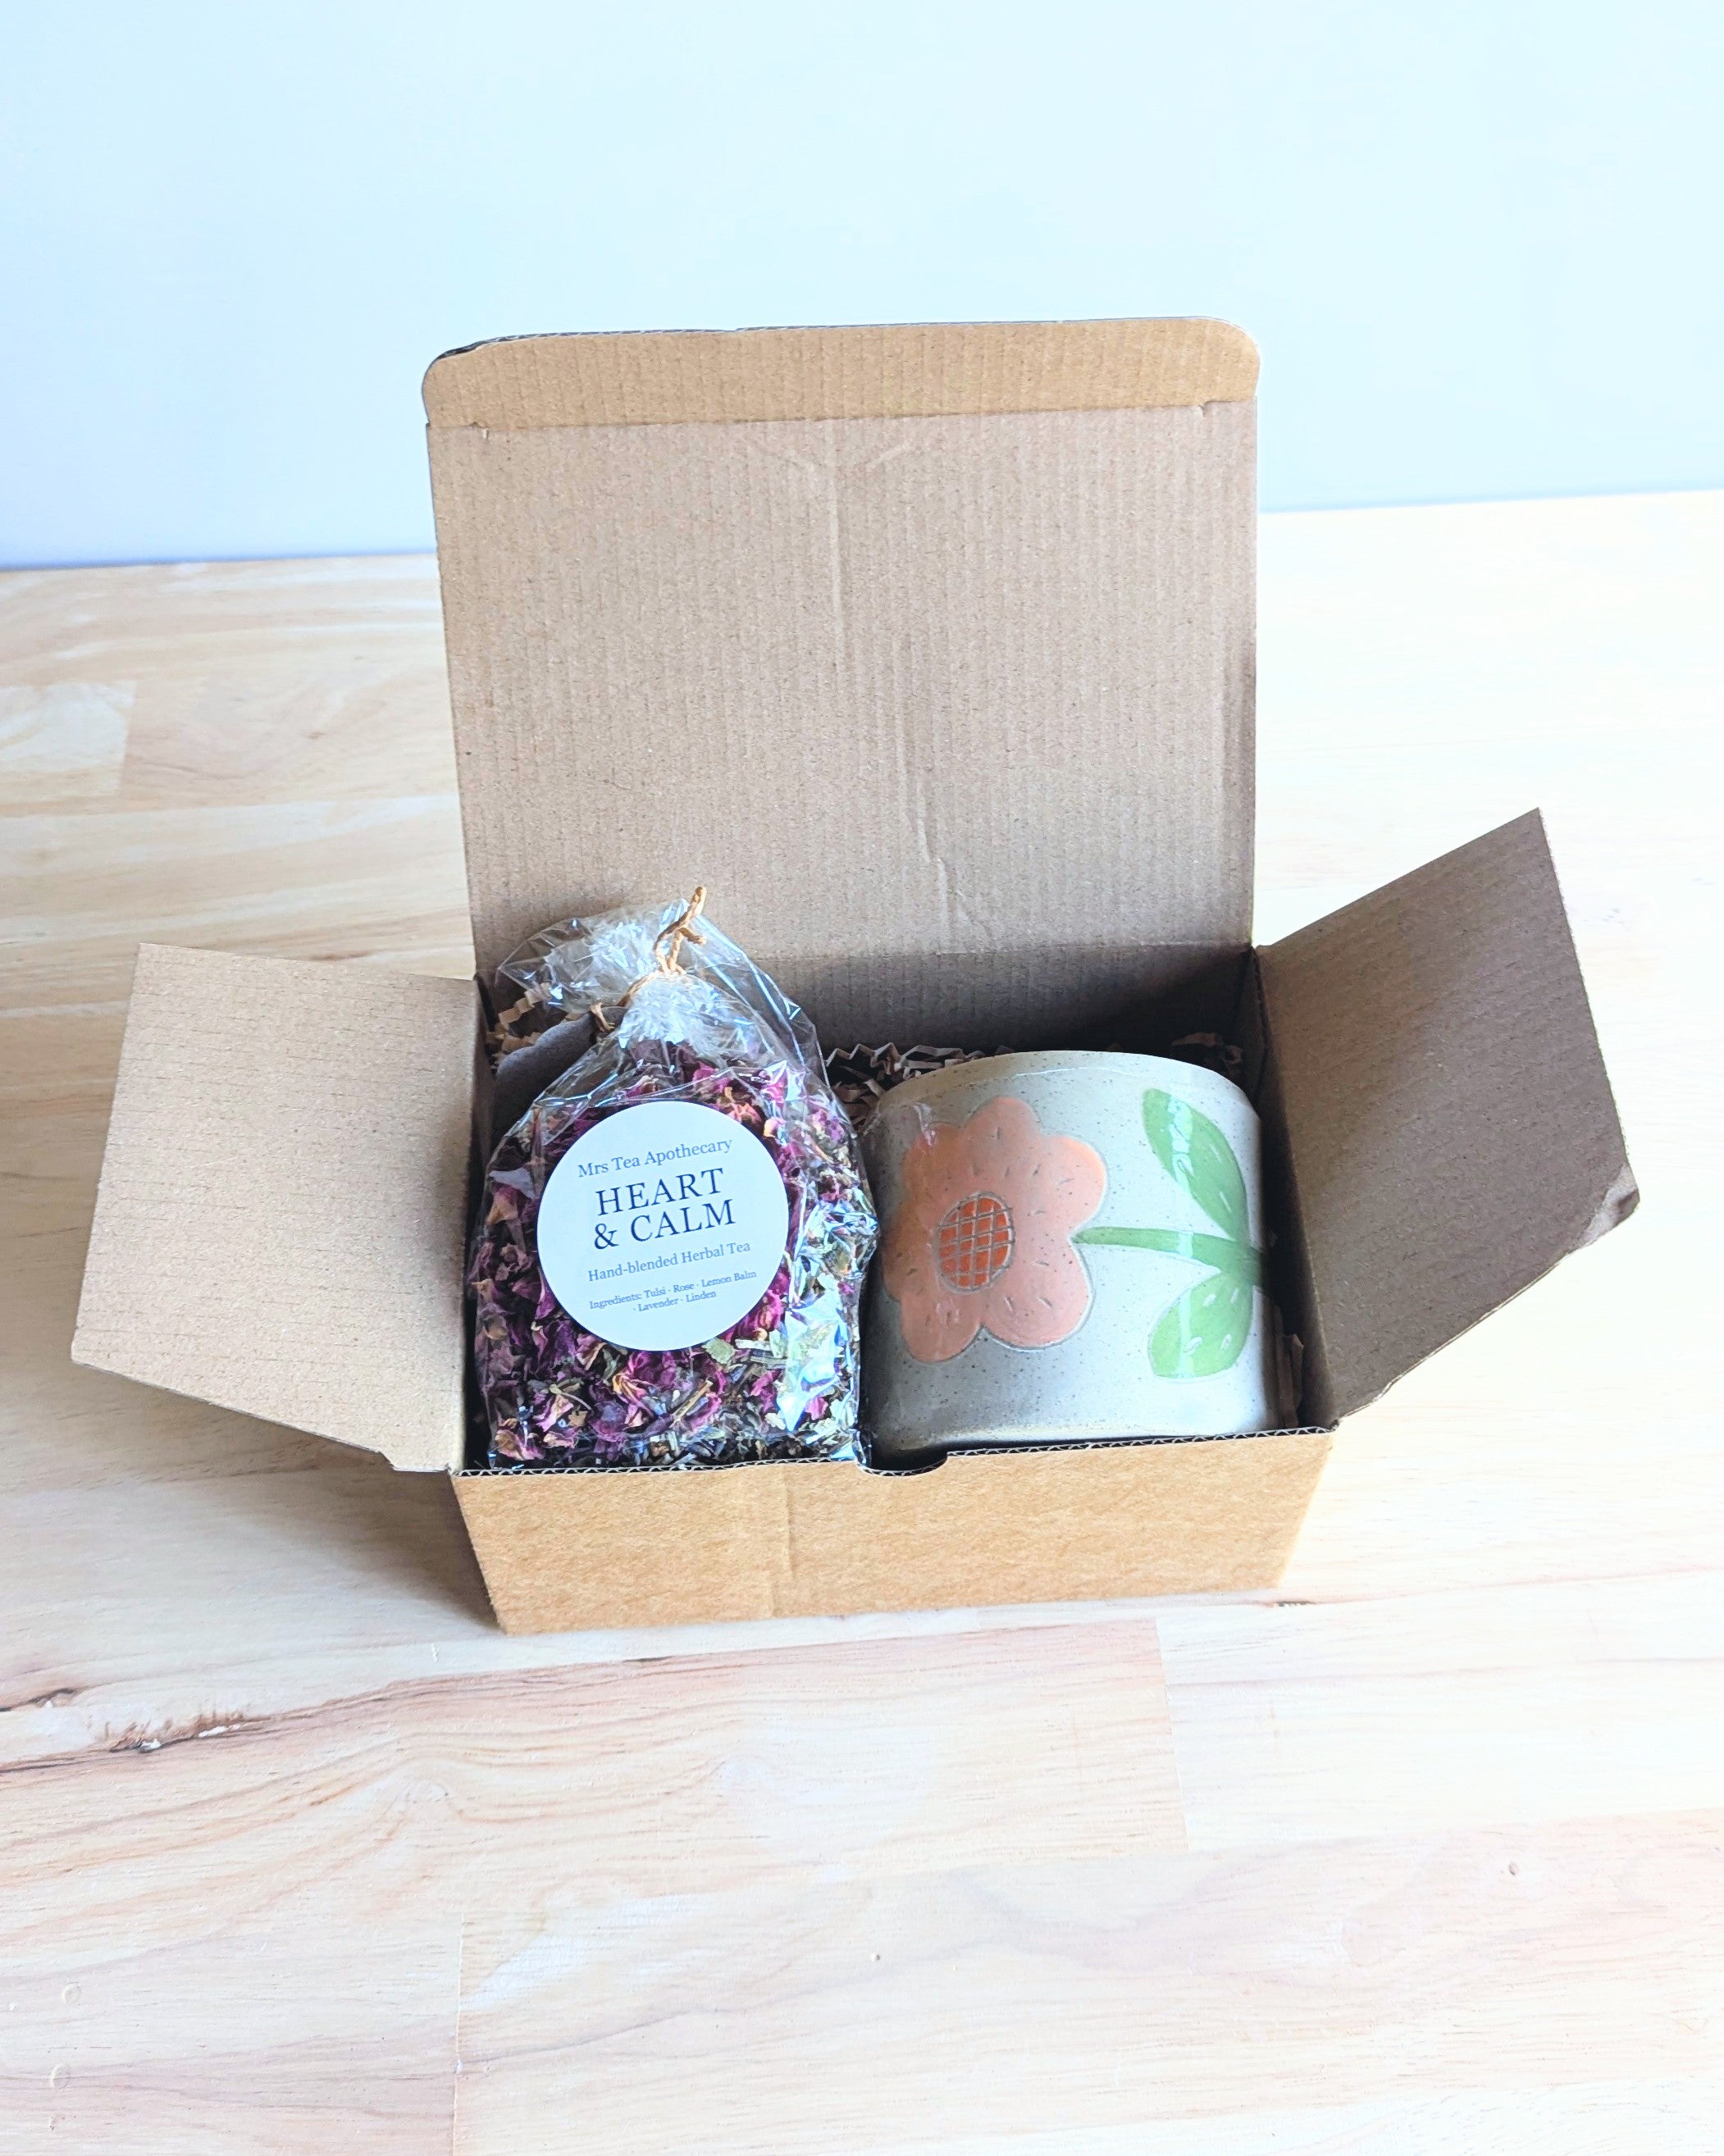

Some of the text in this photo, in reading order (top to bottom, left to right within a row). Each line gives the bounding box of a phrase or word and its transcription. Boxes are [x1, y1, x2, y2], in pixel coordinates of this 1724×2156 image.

[577, 1140, 732, 1178] Mrs Tea Apothecary
[595, 1168, 723, 1216] HEART
[595, 1199, 736, 1249] & CALM
[588, 1242, 750, 1281] Hand-blended Herbal Tea
[590, 1271, 757, 1309] Ingredients: Tulsi Rose Lemon Balm
[638, 1291, 717, 1311] Lavender Linden
